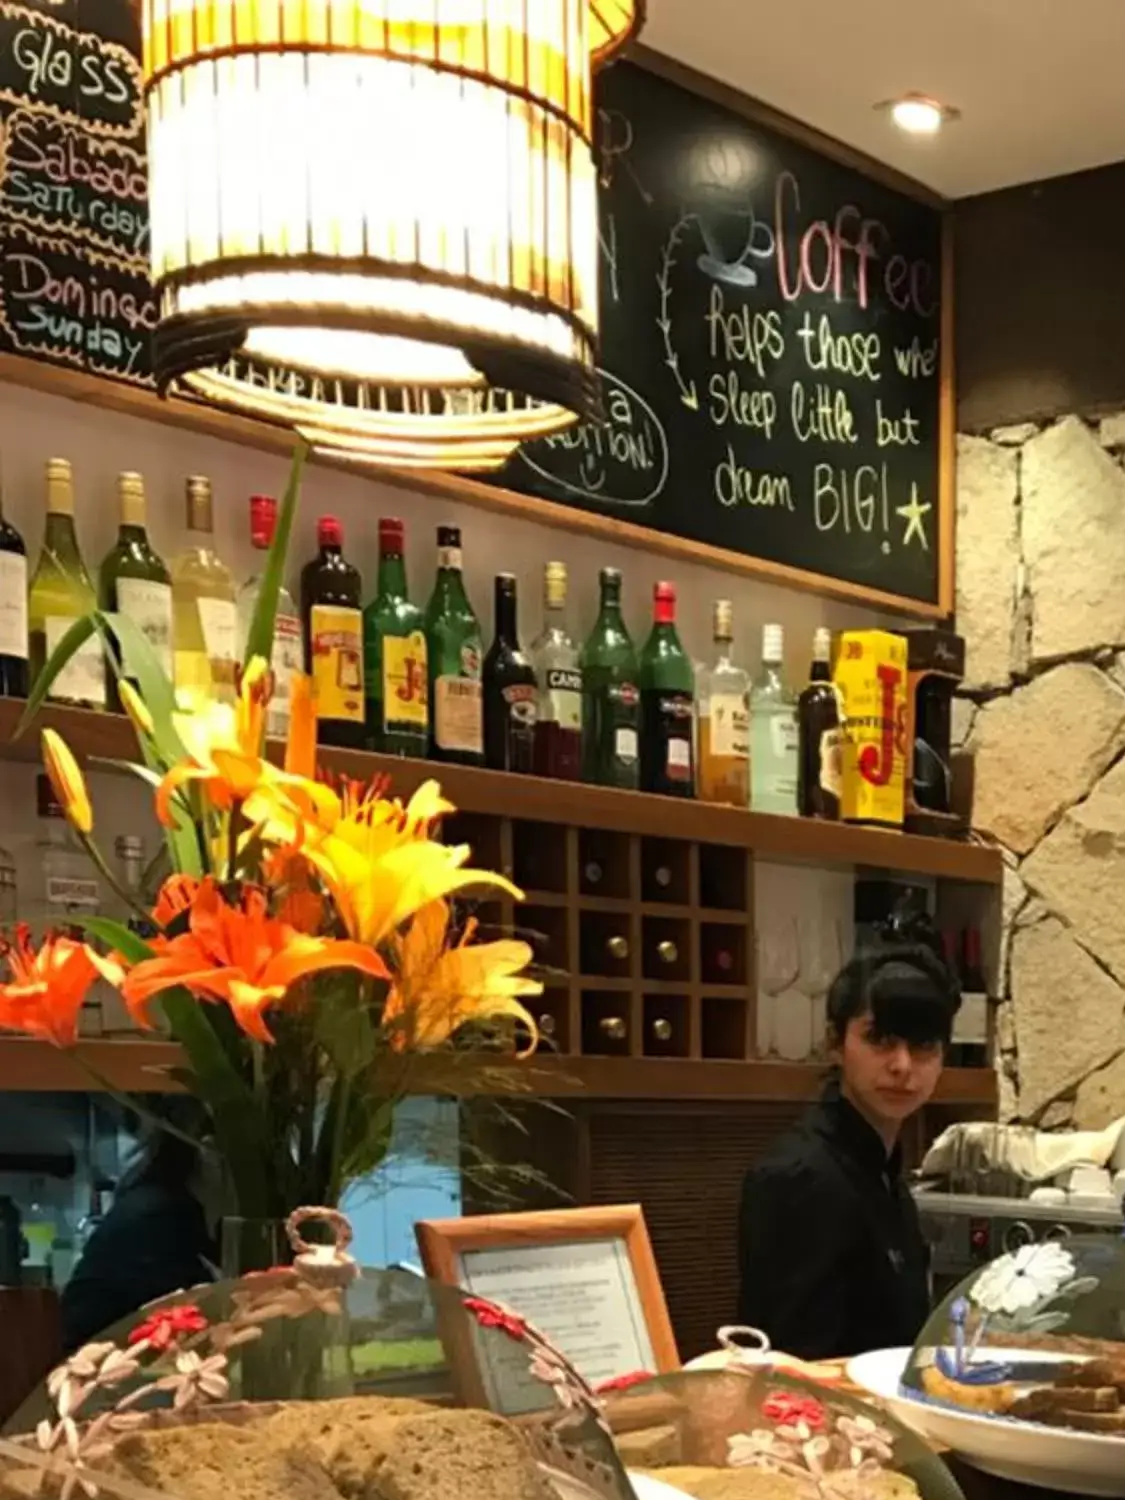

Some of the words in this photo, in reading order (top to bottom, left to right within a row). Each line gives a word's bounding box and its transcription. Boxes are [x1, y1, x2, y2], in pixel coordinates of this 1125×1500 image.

[13, 29, 130, 103] Glass
[776, 170, 937, 318] Coffee
[17, 303, 143, 372] Sunday
[704, 282, 786, 379] helps
[796, 310, 882, 382] those
[790, 379, 860, 443] little
[875, 398, 921, 447] but
[813, 460, 892, 556] BIG!
